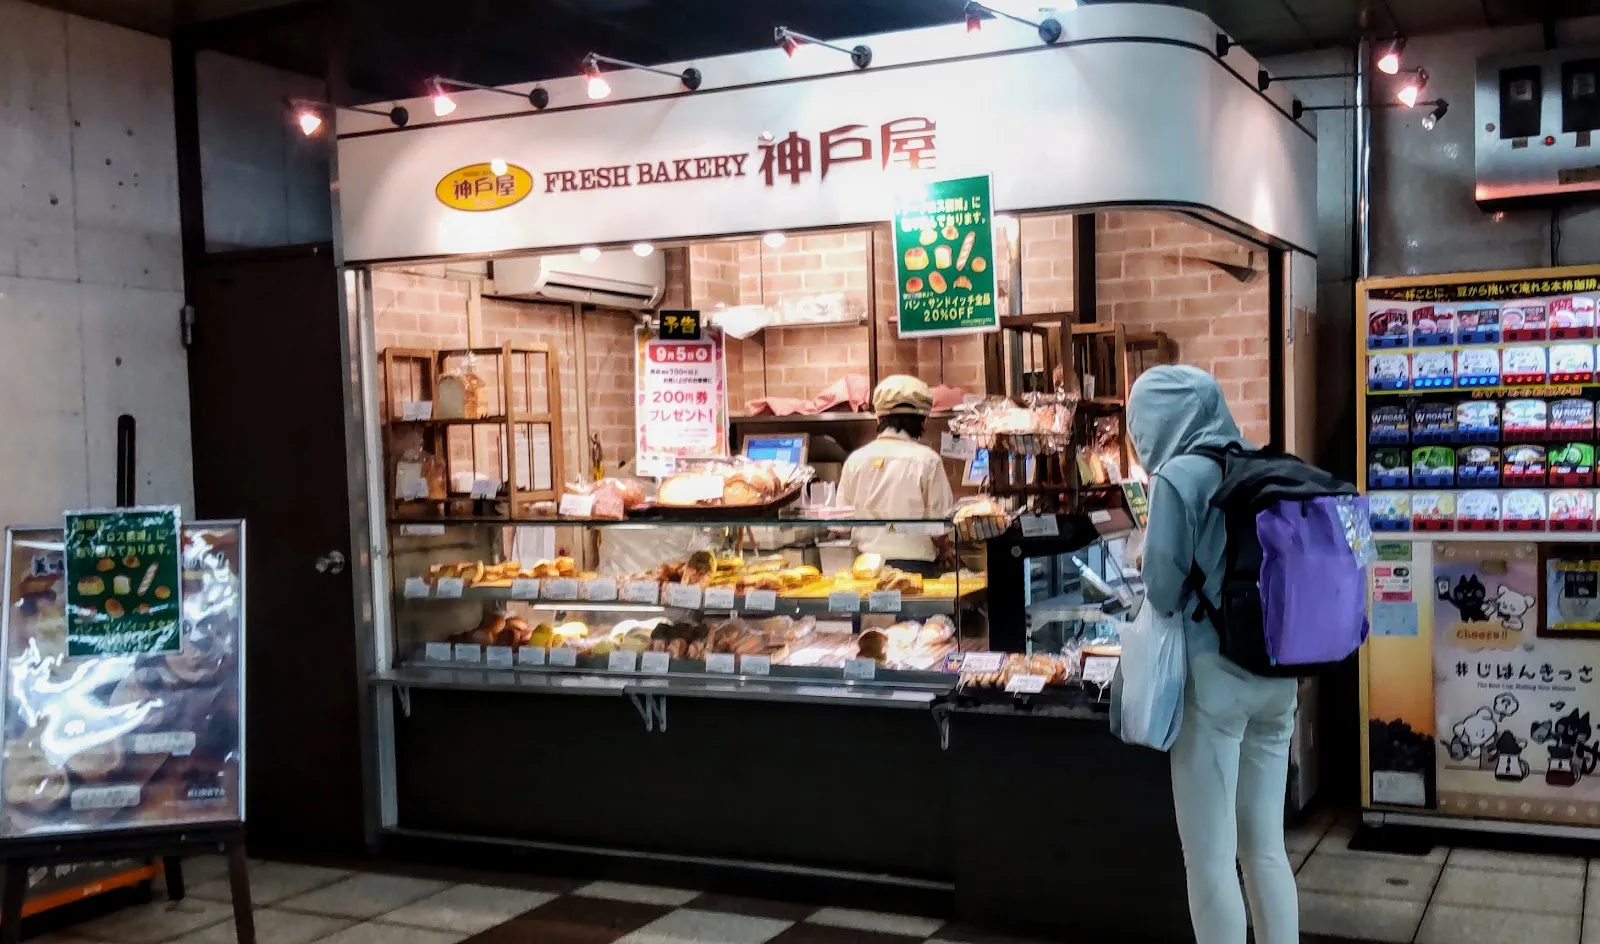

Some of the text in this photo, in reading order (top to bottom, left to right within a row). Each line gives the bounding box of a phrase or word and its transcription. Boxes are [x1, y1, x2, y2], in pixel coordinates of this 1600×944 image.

[543, 116, 937, 194] FRESH BAKERY 神戸屋
[924, 306, 974, 322] 20%OFF
[663, 315, 696, 334] 予告
[652, 390, 708, 404] 200円券
